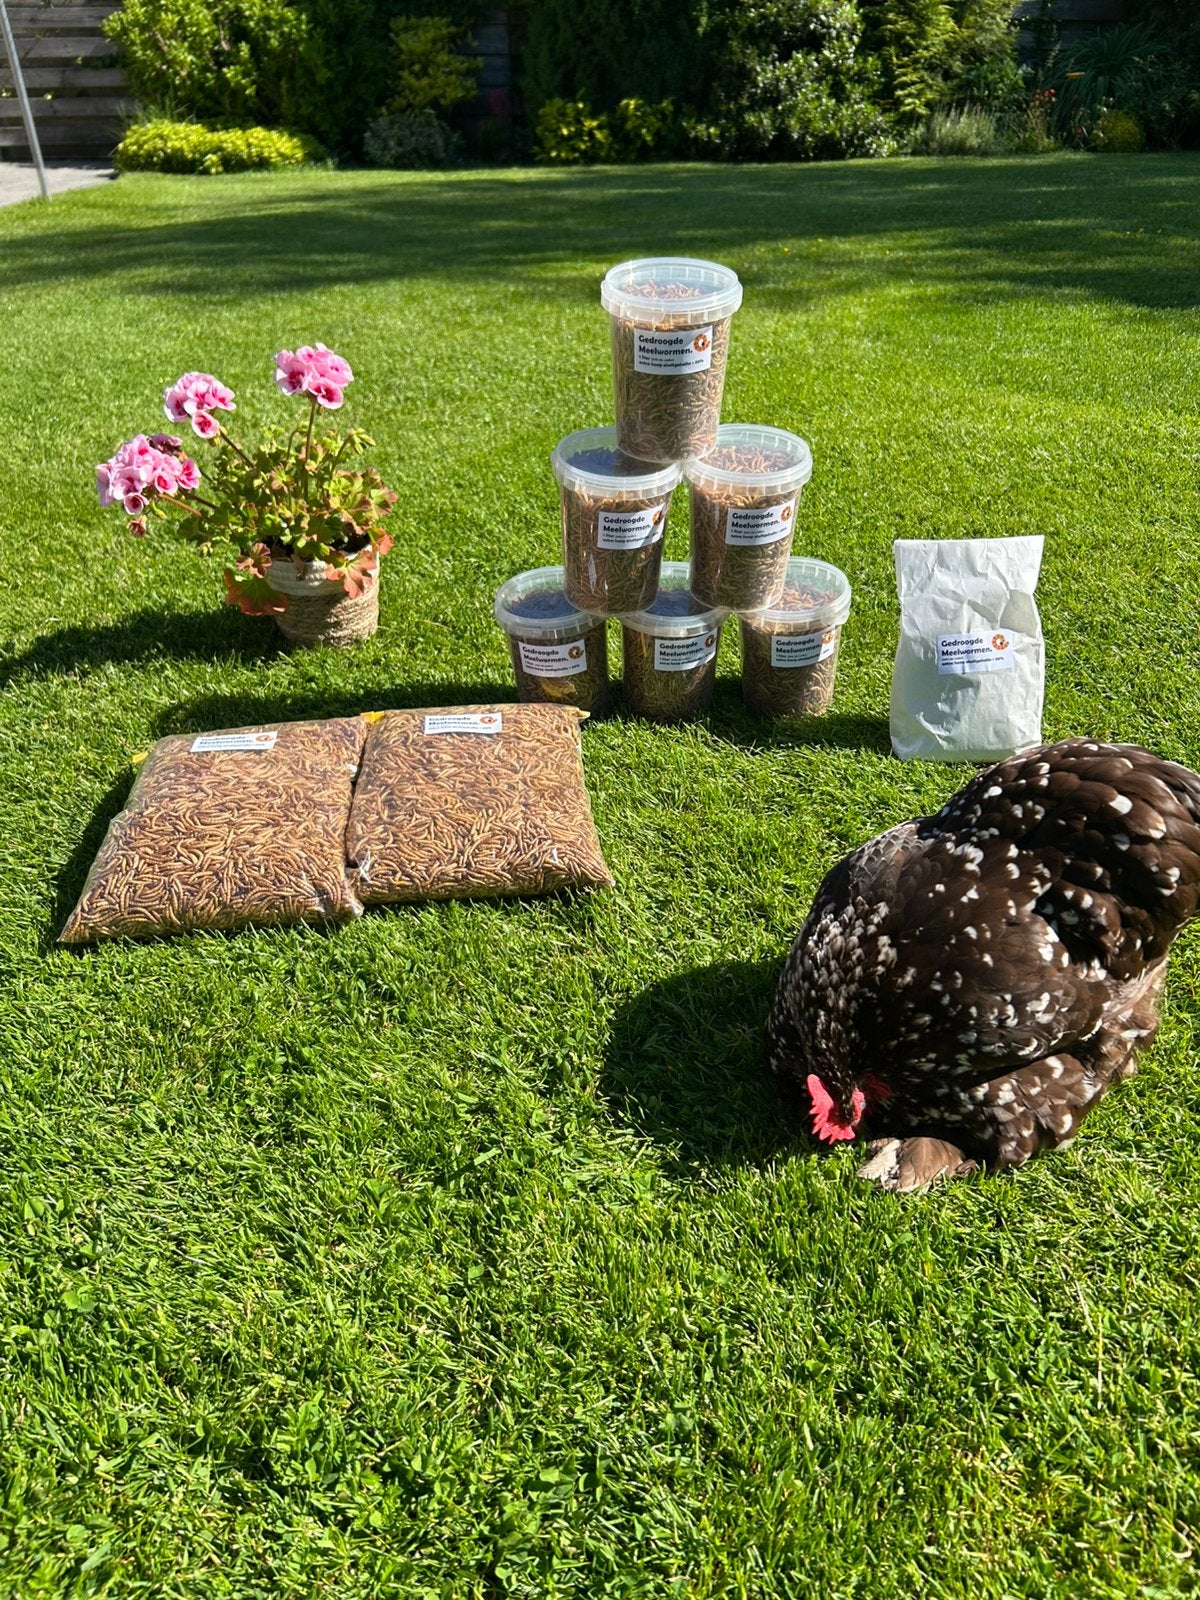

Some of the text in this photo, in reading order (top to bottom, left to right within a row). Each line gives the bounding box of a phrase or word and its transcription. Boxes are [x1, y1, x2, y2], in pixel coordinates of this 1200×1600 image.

[639, 335, 684, 346] Gedroogde
[639, 345, 693, 355] Meelwormen.
[603, 516, 645, 524] Gedroogde
[732, 512, 774, 520] Gedroogde
[603, 524, 652, 533] Meelwormen.
[731, 520, 780, 529] Meelwormen.
[659, 641, 698, 649] Gedroogde
[776, 638, 815, 646] Gedroogde
[941, 637, 983, 647] Gedroogde
[522, 646, 559, 656] Gedroogde
[941, 647, 993, 656] Meelwormen.
